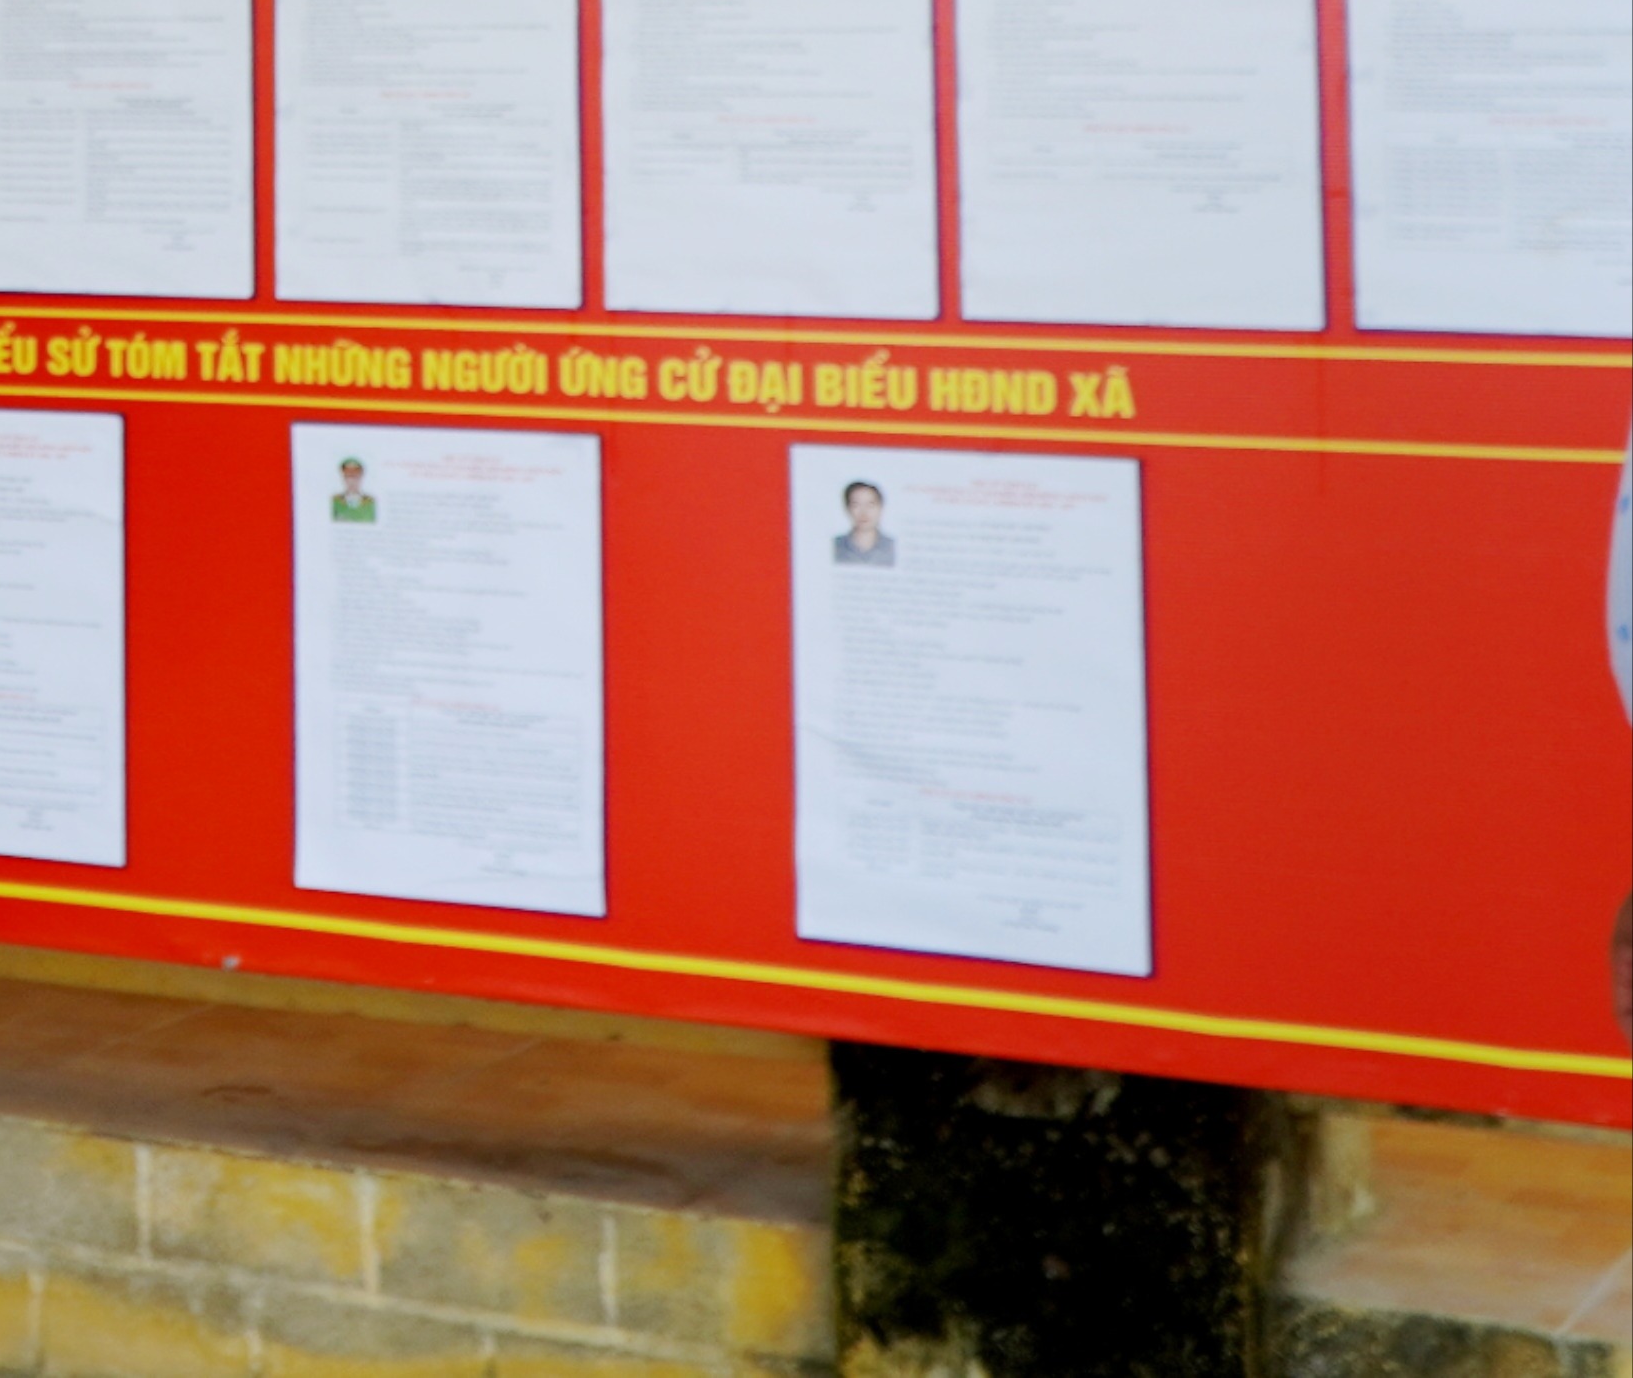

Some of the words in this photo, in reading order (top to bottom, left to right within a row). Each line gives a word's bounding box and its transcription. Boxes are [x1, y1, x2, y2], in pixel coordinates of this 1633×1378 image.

[47, 327, 101, 376] SỬ
[106, 334, 186, 379] TÓM
[196, 330, 264, 382] TẮT
[274, 340, 411, 388] NHỮNG
[422, 344, 548, 394] NGƯỜI
[559, 348, 647, 398] ỨNG
[659, 347, 722, 402] CỬ
[727, 361, 802, 413] ĐẠI
[815, 351, 917, 410] BIỂU
[929, 368, 1056, 415] HĐND
[1070, 367, 1135, 419] XÃ
